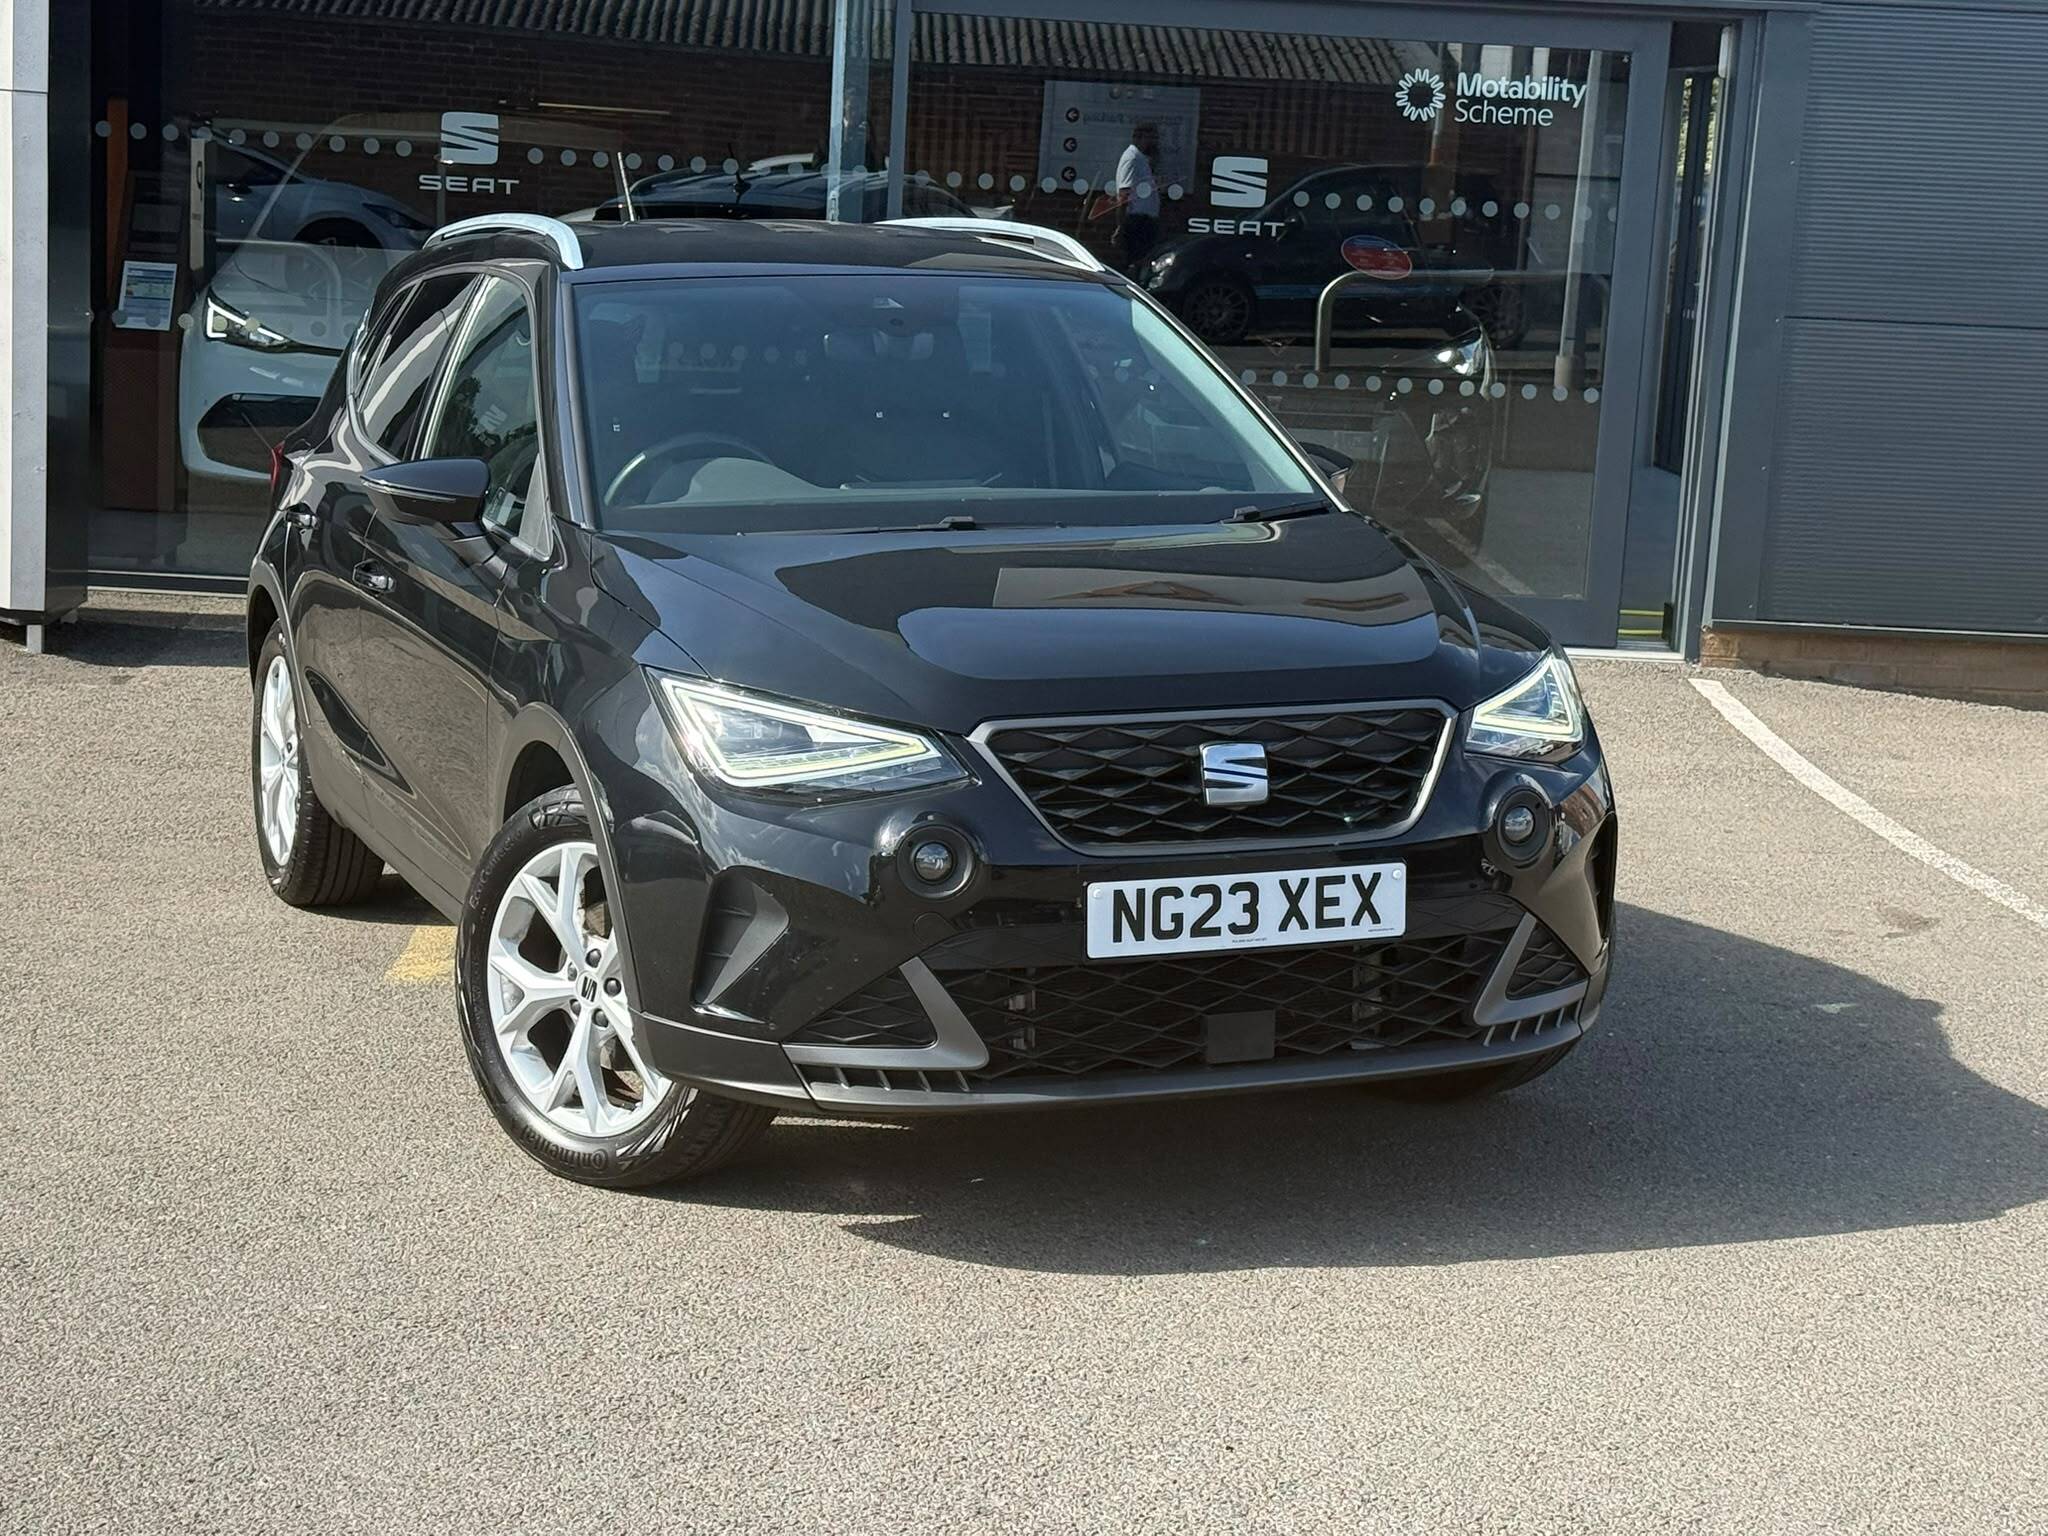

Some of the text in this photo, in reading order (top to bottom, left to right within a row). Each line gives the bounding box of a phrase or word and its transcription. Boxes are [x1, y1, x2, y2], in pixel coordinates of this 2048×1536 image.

[1456, 72, 1587, 108] Motability
[1454, 99, 1554, 127] Scheme
[419, 175, 520, 195] SEAT
[1188, 218, 1286, 238] SEAT
[1113, 872, 1382, 943] NG23 XEX
